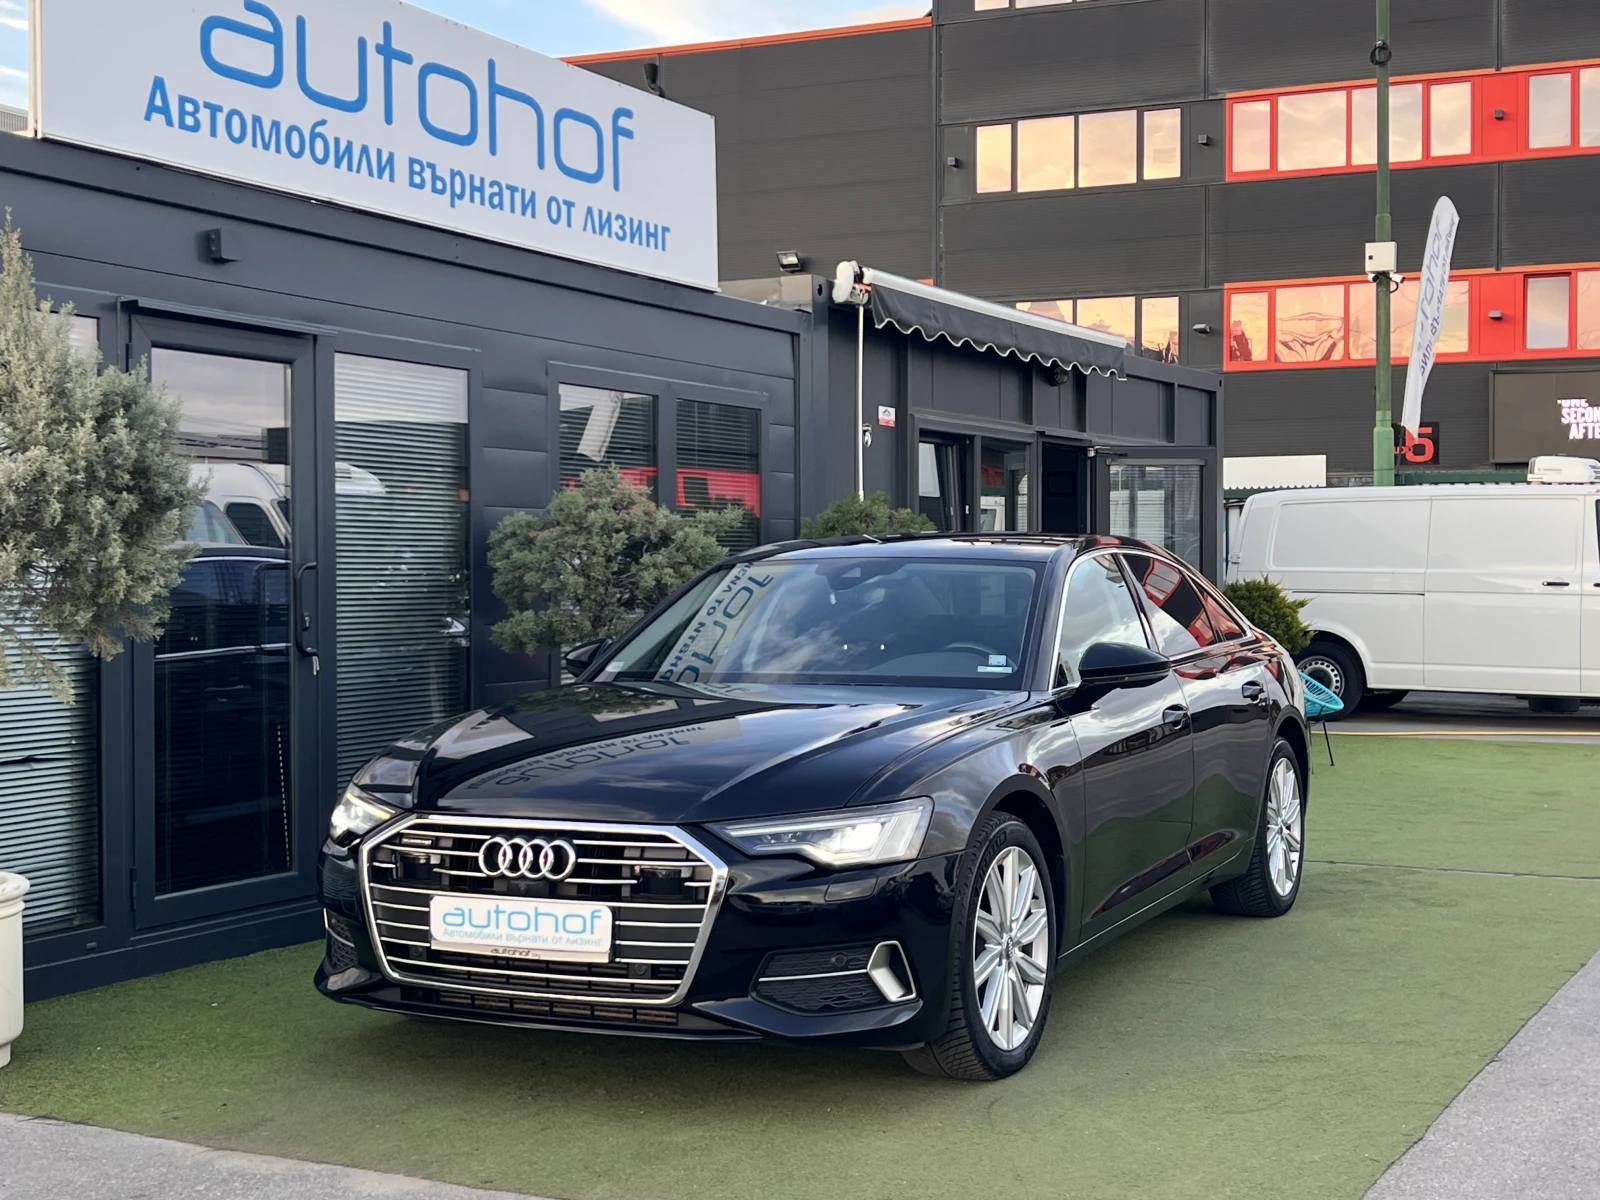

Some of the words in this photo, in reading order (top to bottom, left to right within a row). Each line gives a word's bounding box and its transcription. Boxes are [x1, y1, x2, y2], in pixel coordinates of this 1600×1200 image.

[199, 0, 635, 192] autohof
[143, 75, 395, 183] Автомобили
[408, 156, 537, 219] върнати
[546, 195, 576, 229] от
[582, 205, 671, 252] лизинг
[442, 904, 602, 935] autohof
[442, 928, 503, 943] Автомобили
[506, 934, 549, 946] върнати
[551, 937, 563, 945] от
[565, 938, 602, 947] лизинг
[490, 948, 531, 957] autohof
